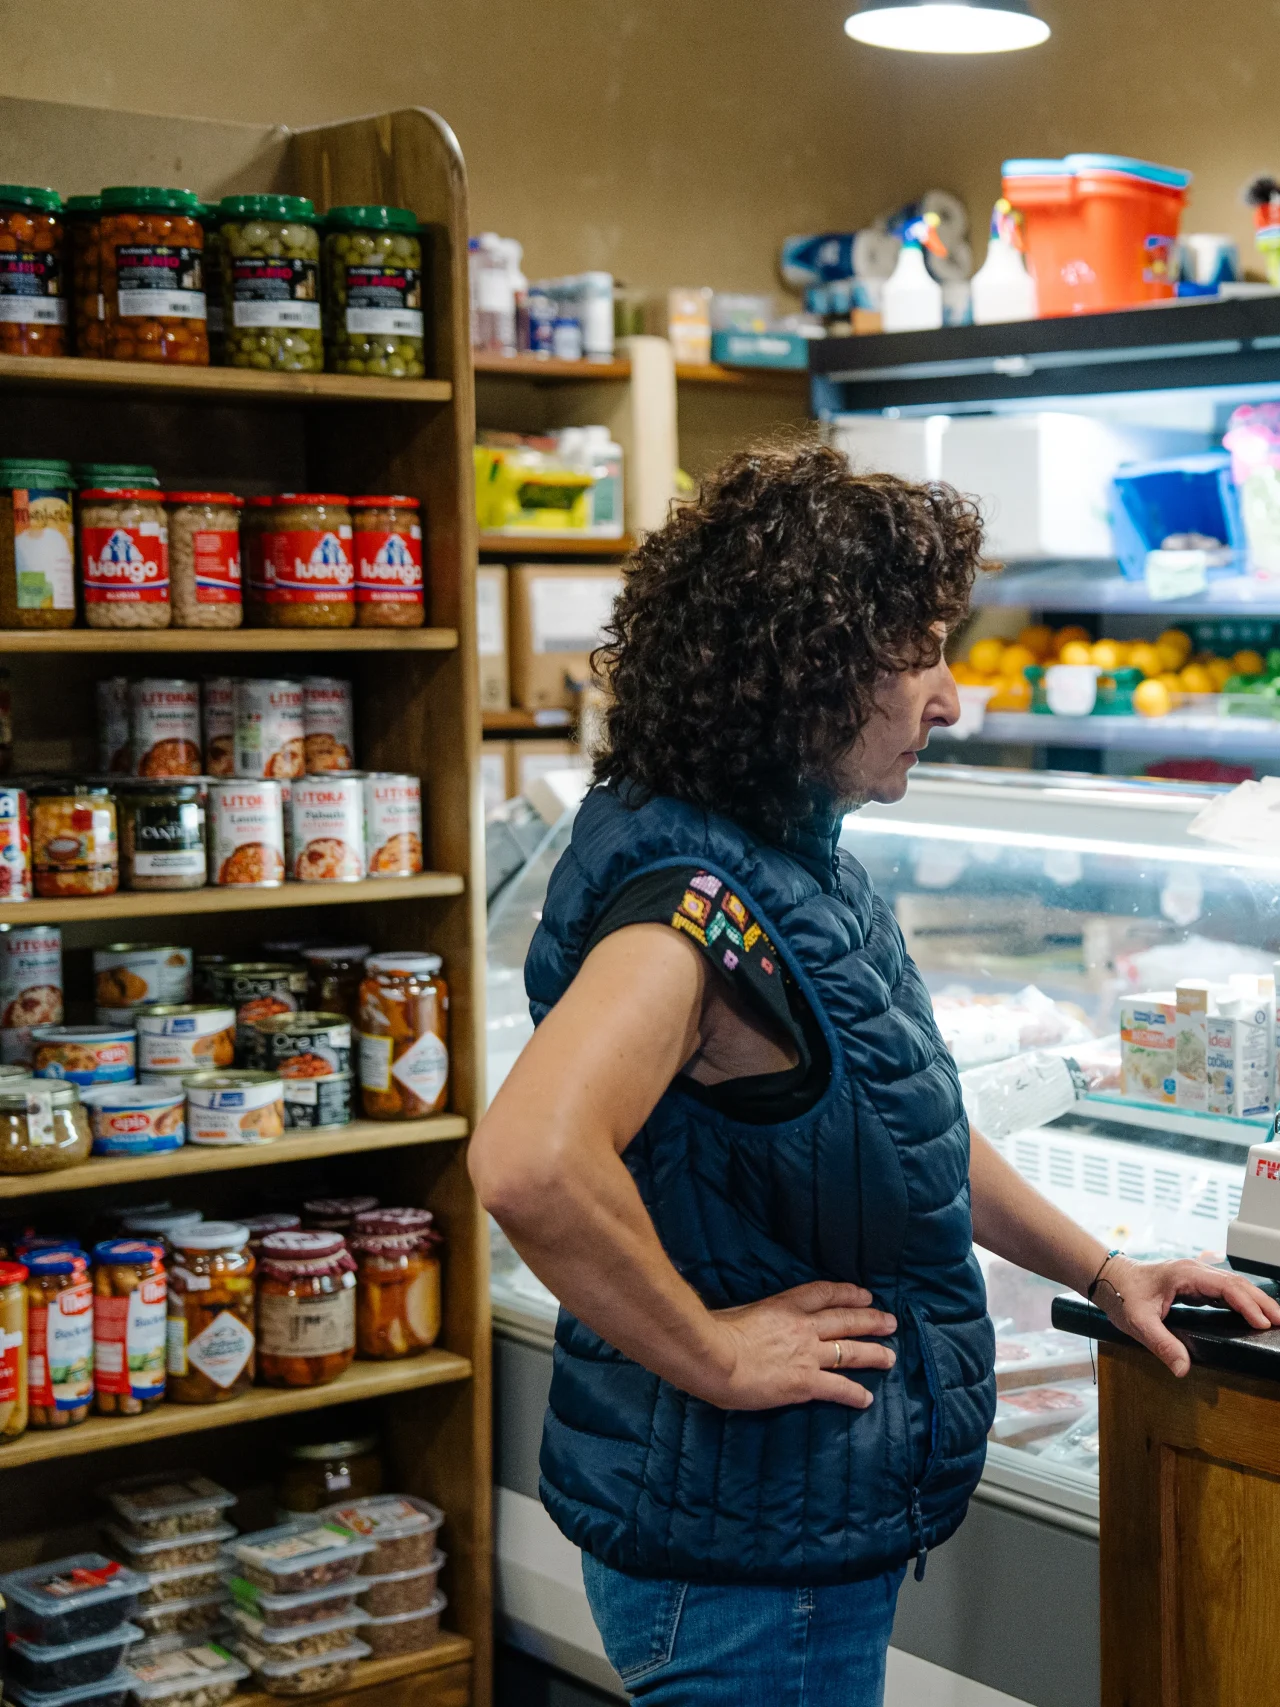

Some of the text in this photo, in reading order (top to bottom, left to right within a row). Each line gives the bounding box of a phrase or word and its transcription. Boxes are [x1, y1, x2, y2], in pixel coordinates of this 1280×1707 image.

[88, 555, 158, 583] luengo
[294, 556, 354, 586] luengo
[360, 557, 422, 586] luengo
[112, 1115, 149, 1132] apis
